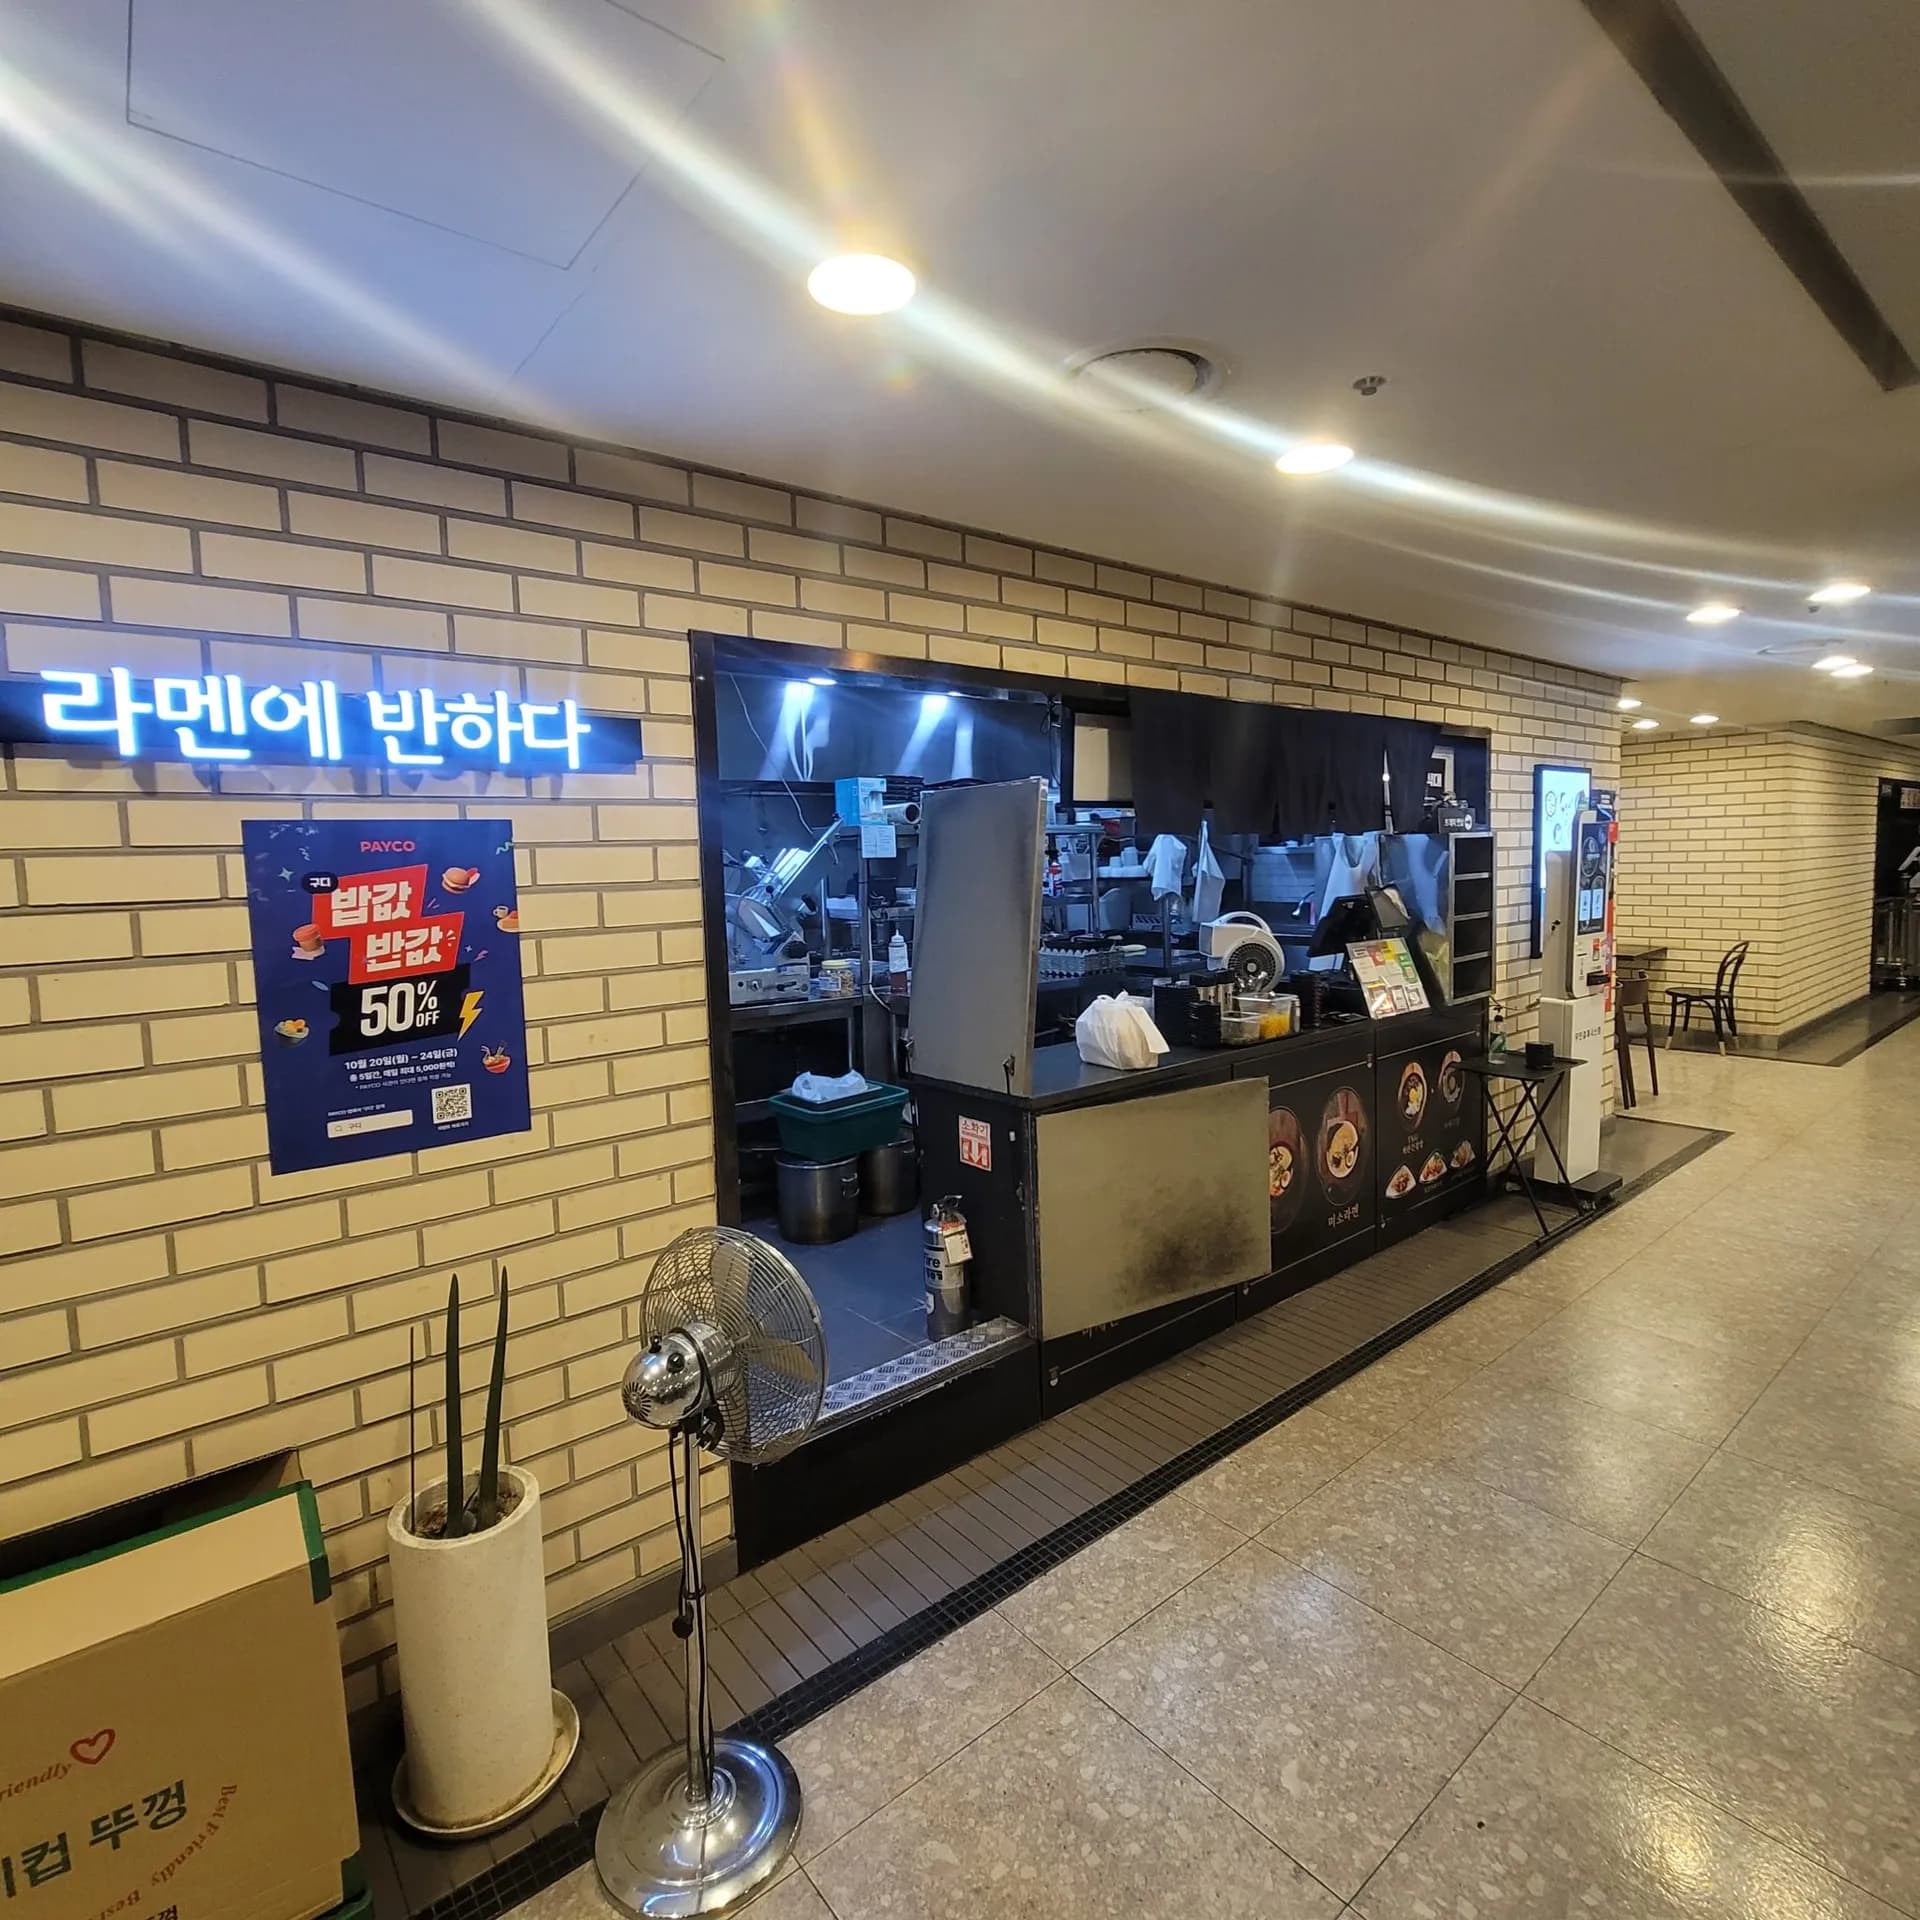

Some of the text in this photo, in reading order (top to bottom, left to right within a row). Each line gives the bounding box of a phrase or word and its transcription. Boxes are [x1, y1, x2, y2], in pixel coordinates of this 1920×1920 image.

[40, 667, 591, 769] 라멘에 반하다
[360, 840, 416, 852] PAYCO
[309, 876, 331, 888] 구디
[331, 880, 412, 928] 밥값
[366, 926, 443, 973] 반값
[361, 980, 438, 1037] 50%
[416, 1010, 440, 1028] OFF
[344, 1059, 368, 1070] 10월
[369, 1054, 409, 1067] 20일(월)
[420, 1048, 458, 1060] 24일(금)
[1328, 1203, 1360, 1228] 미소라멘
[89, 1779, 187, 1851] 뚜껑
